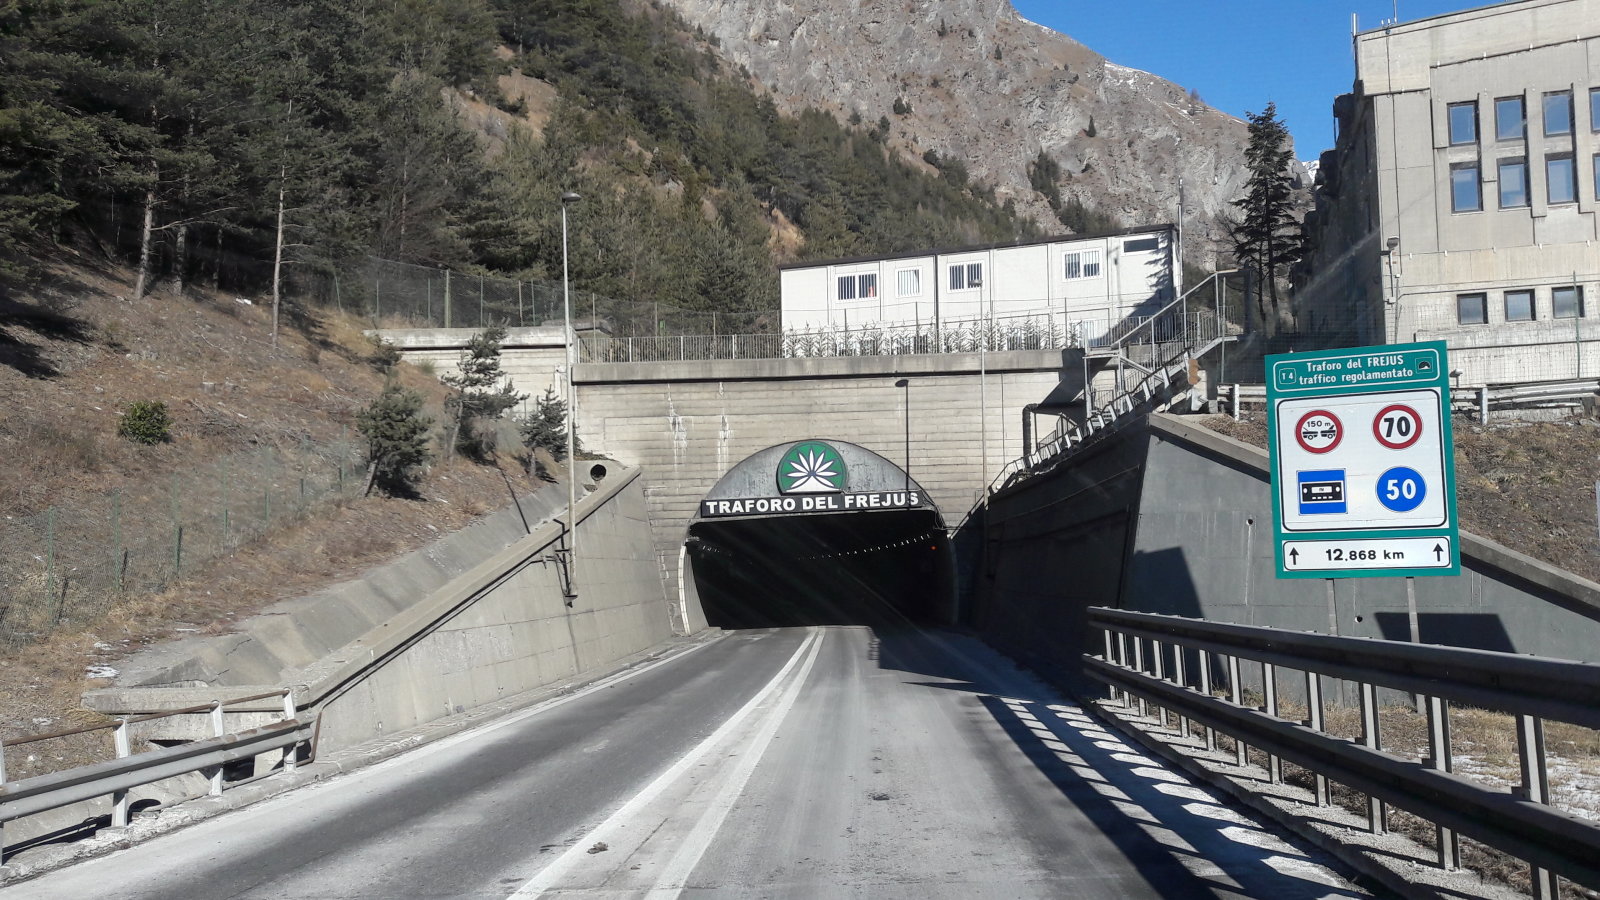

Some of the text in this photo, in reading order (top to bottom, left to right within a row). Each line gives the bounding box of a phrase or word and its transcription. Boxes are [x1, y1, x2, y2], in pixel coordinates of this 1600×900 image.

[1306, 355, 1404, 372] Traforo del FREJUS
[1299, 369, 1413, 385] traffico regolamentato
[1306, 420, 1323, 428] 150
[1383, 416, 1411, 438] 70
[1386, 478, 1417, 500] 50
[705, 492, 919, 514] TRAFORO DEL FREJUS
[1325, 548, 1405, 562] 12.868 km
